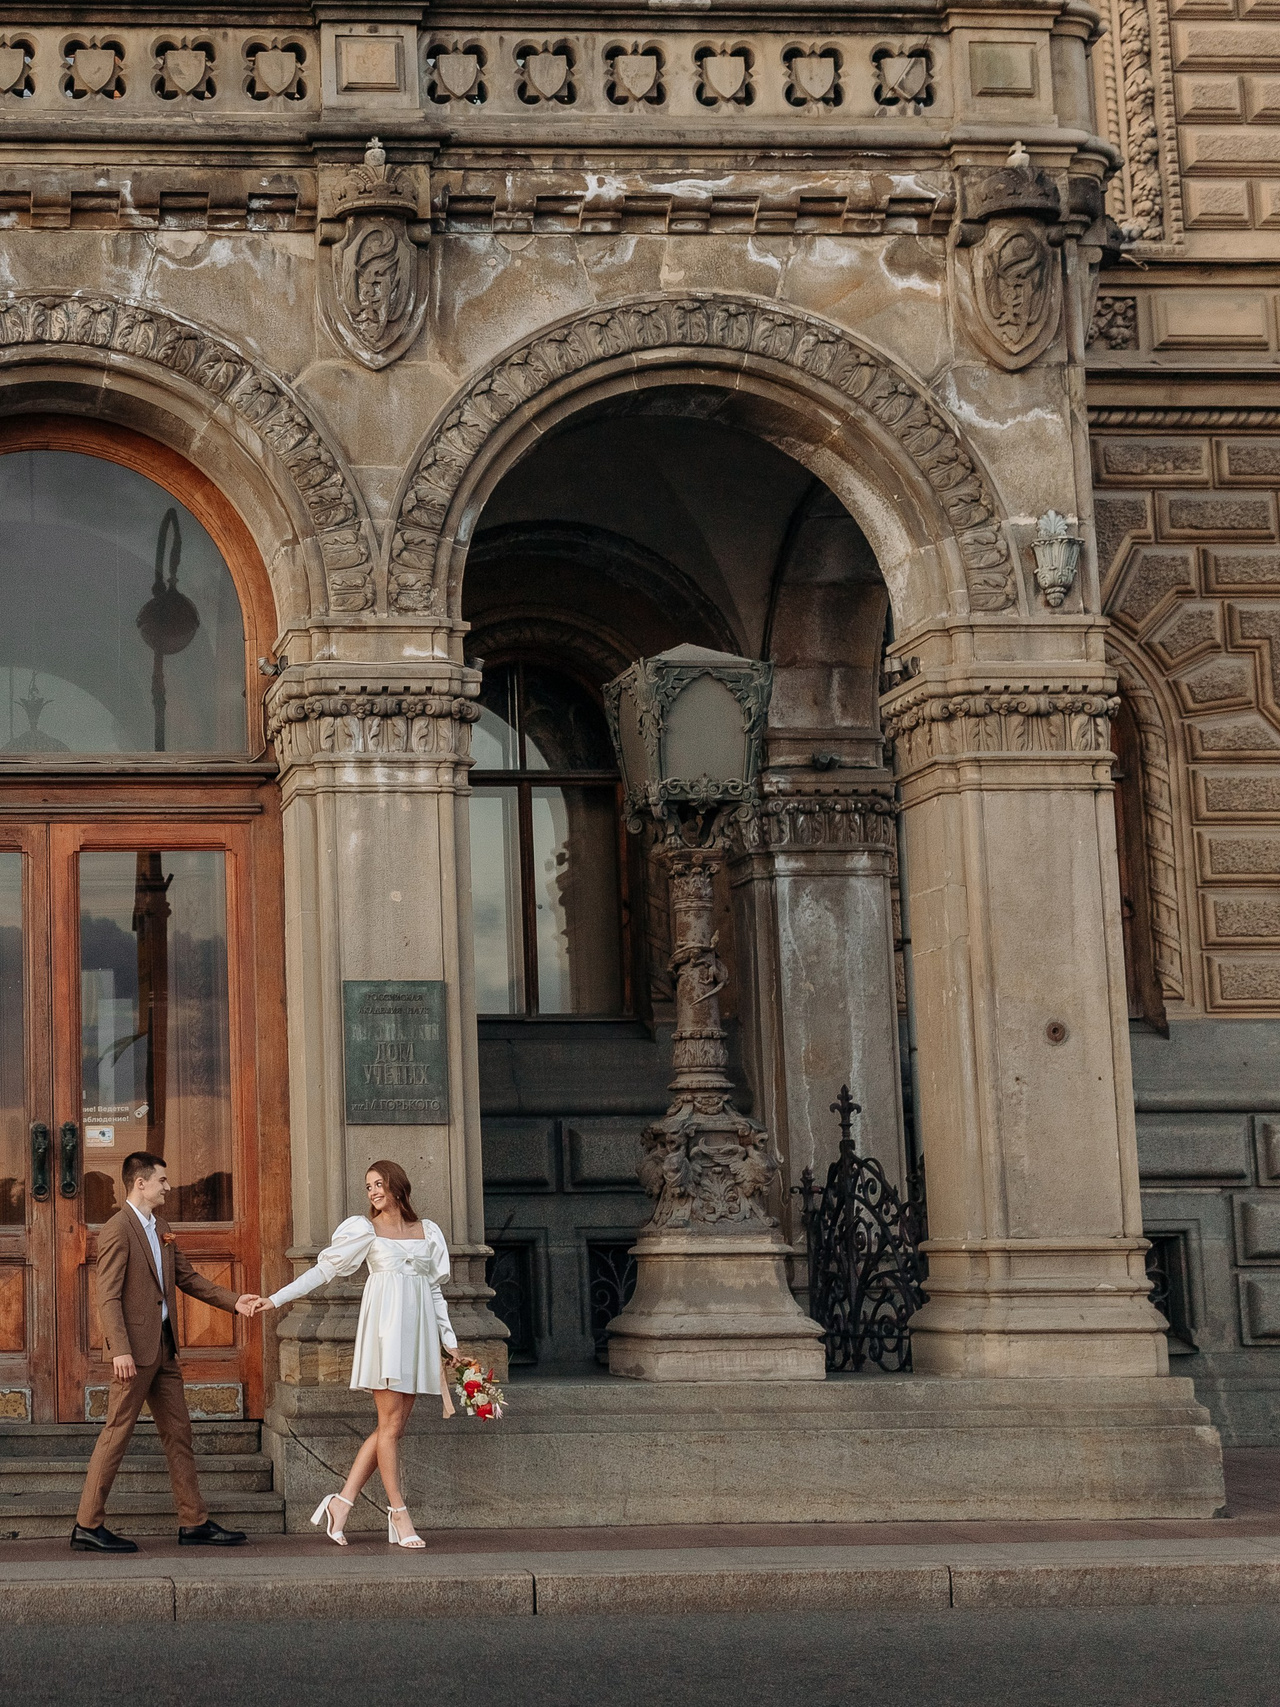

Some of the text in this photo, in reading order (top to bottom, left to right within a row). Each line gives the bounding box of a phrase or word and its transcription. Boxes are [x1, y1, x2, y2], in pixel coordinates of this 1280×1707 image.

[375, 1041, 414, 1063] ДОМ
[97, 1105, 130, 1113] Ведется
[380, 1098, 441, 1111] ГОРЬКОГО
